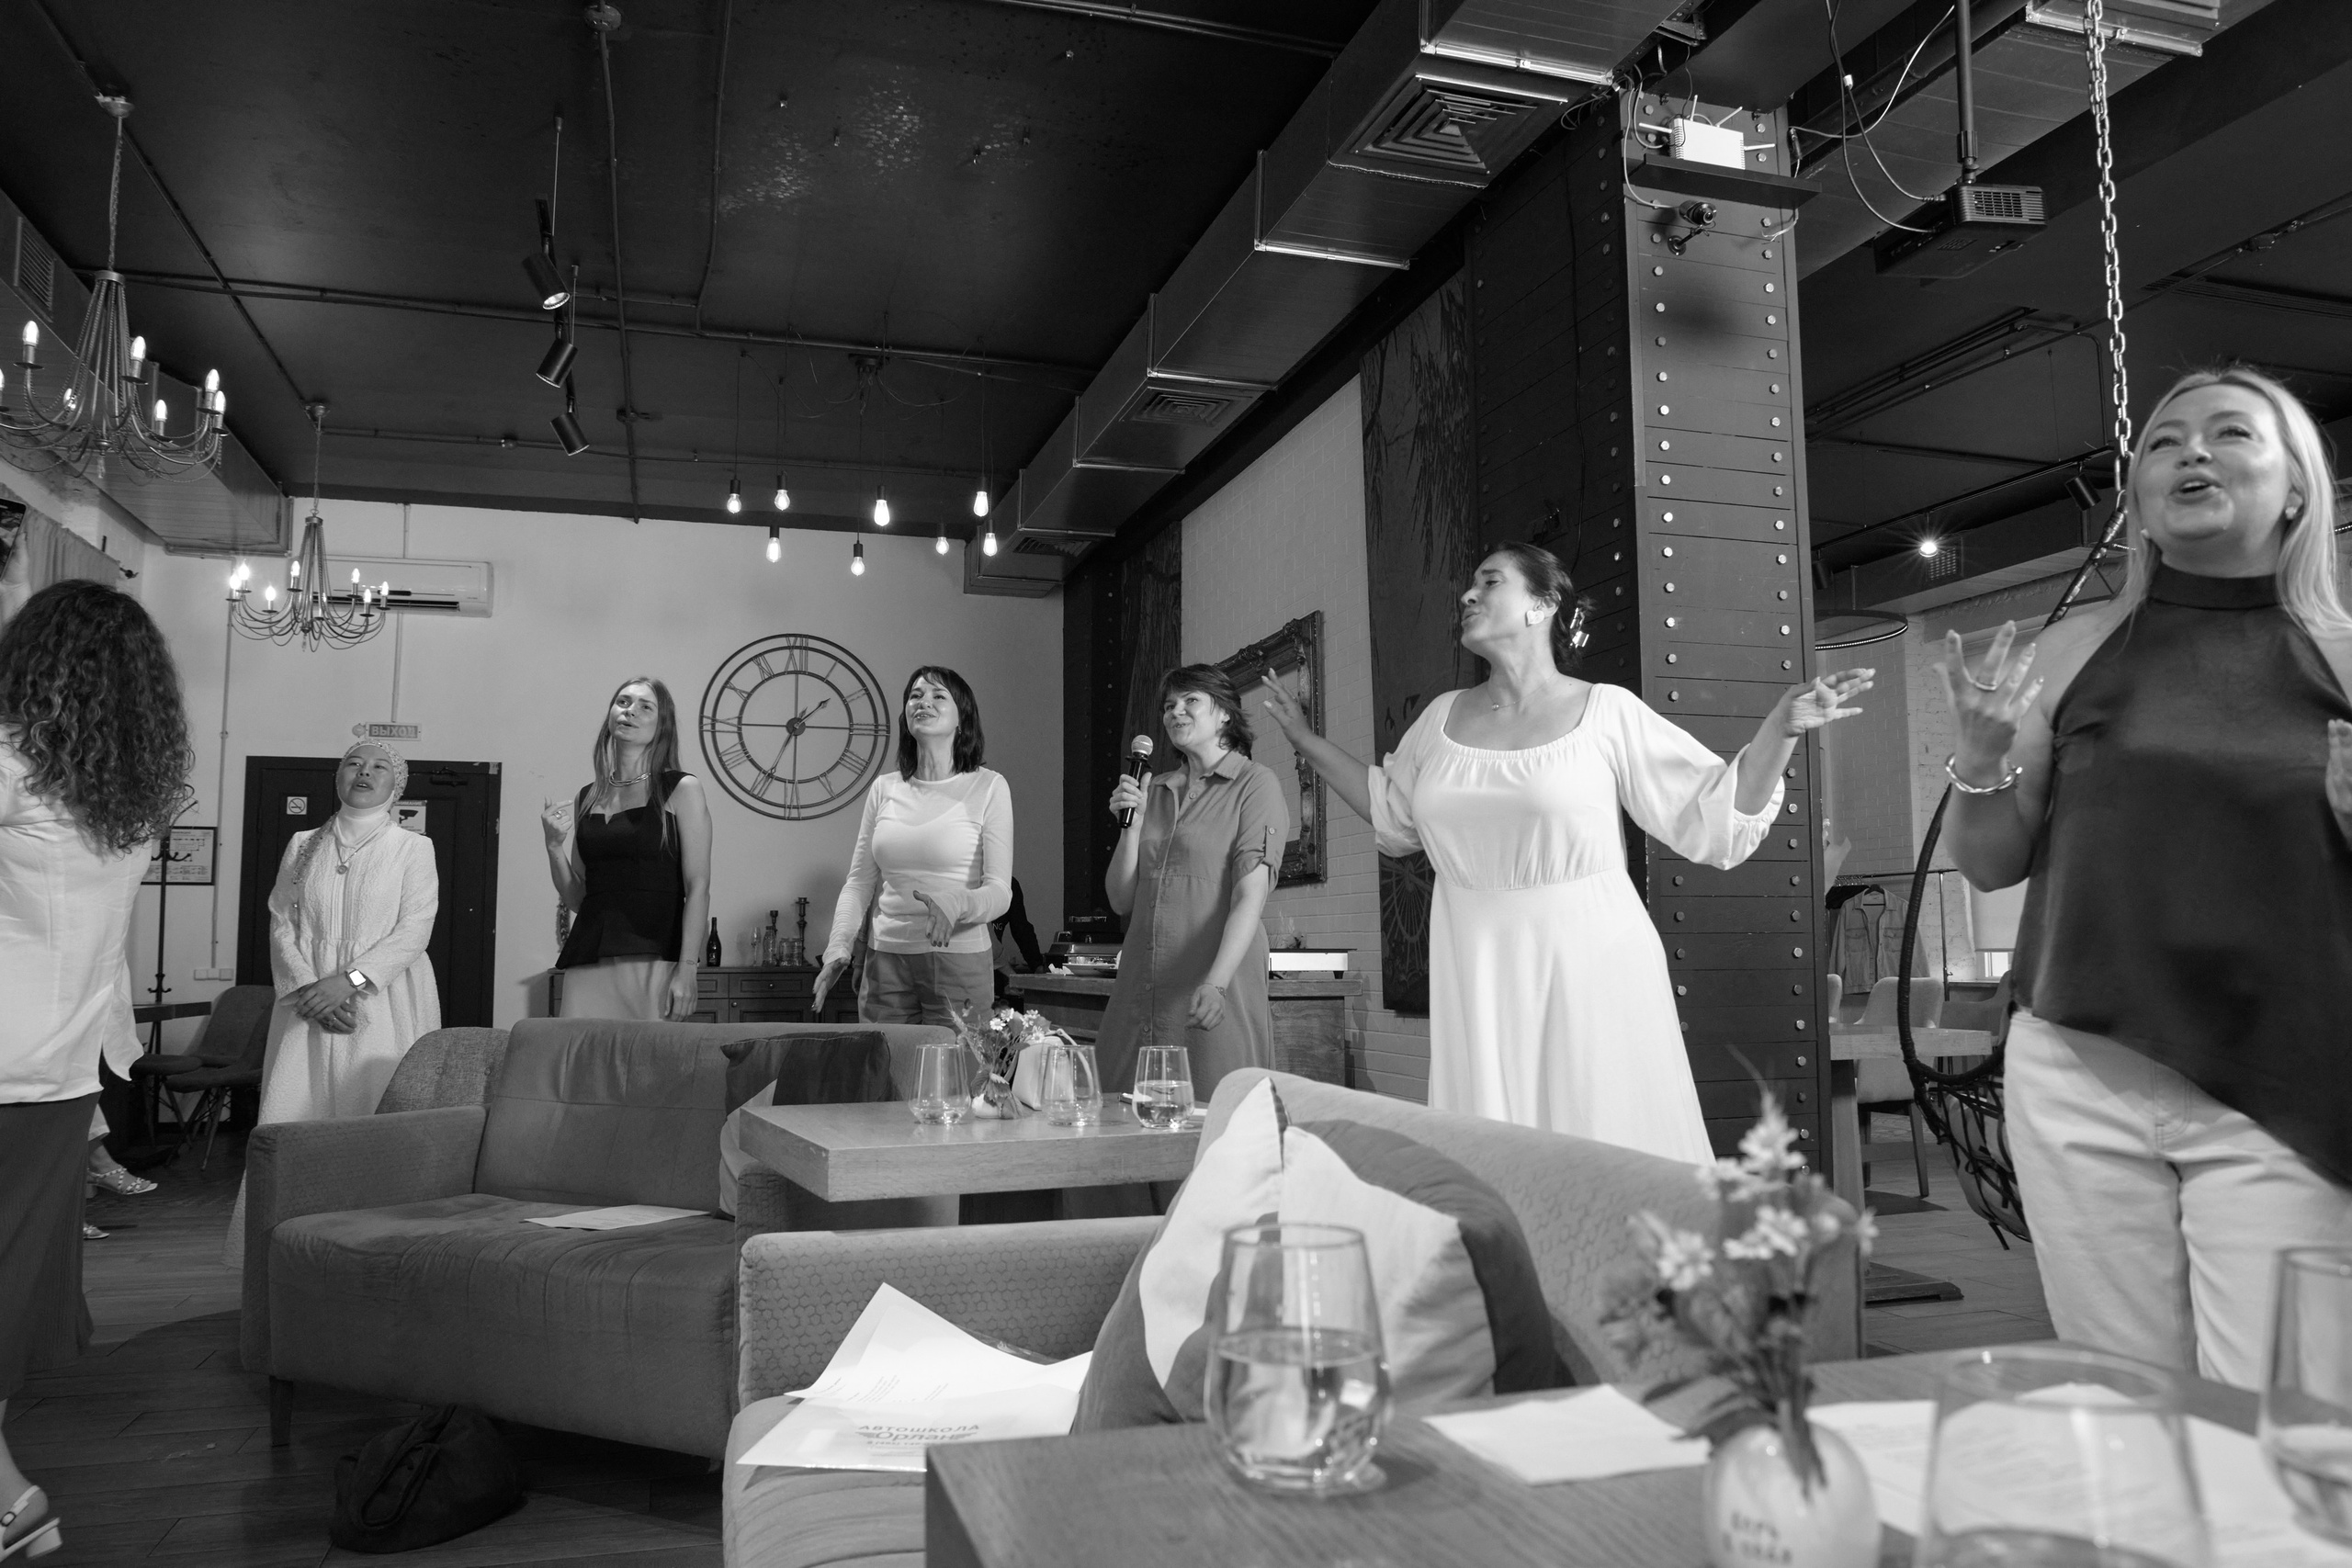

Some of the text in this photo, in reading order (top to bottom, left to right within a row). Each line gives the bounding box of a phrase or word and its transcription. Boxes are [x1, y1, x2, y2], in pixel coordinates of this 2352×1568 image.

[371, 726, 416, 737] ВЫХОД
[858, 1424, 980, 1433] АВТОШКОЛА
[875, 1431, 957, 1441] Орлан
